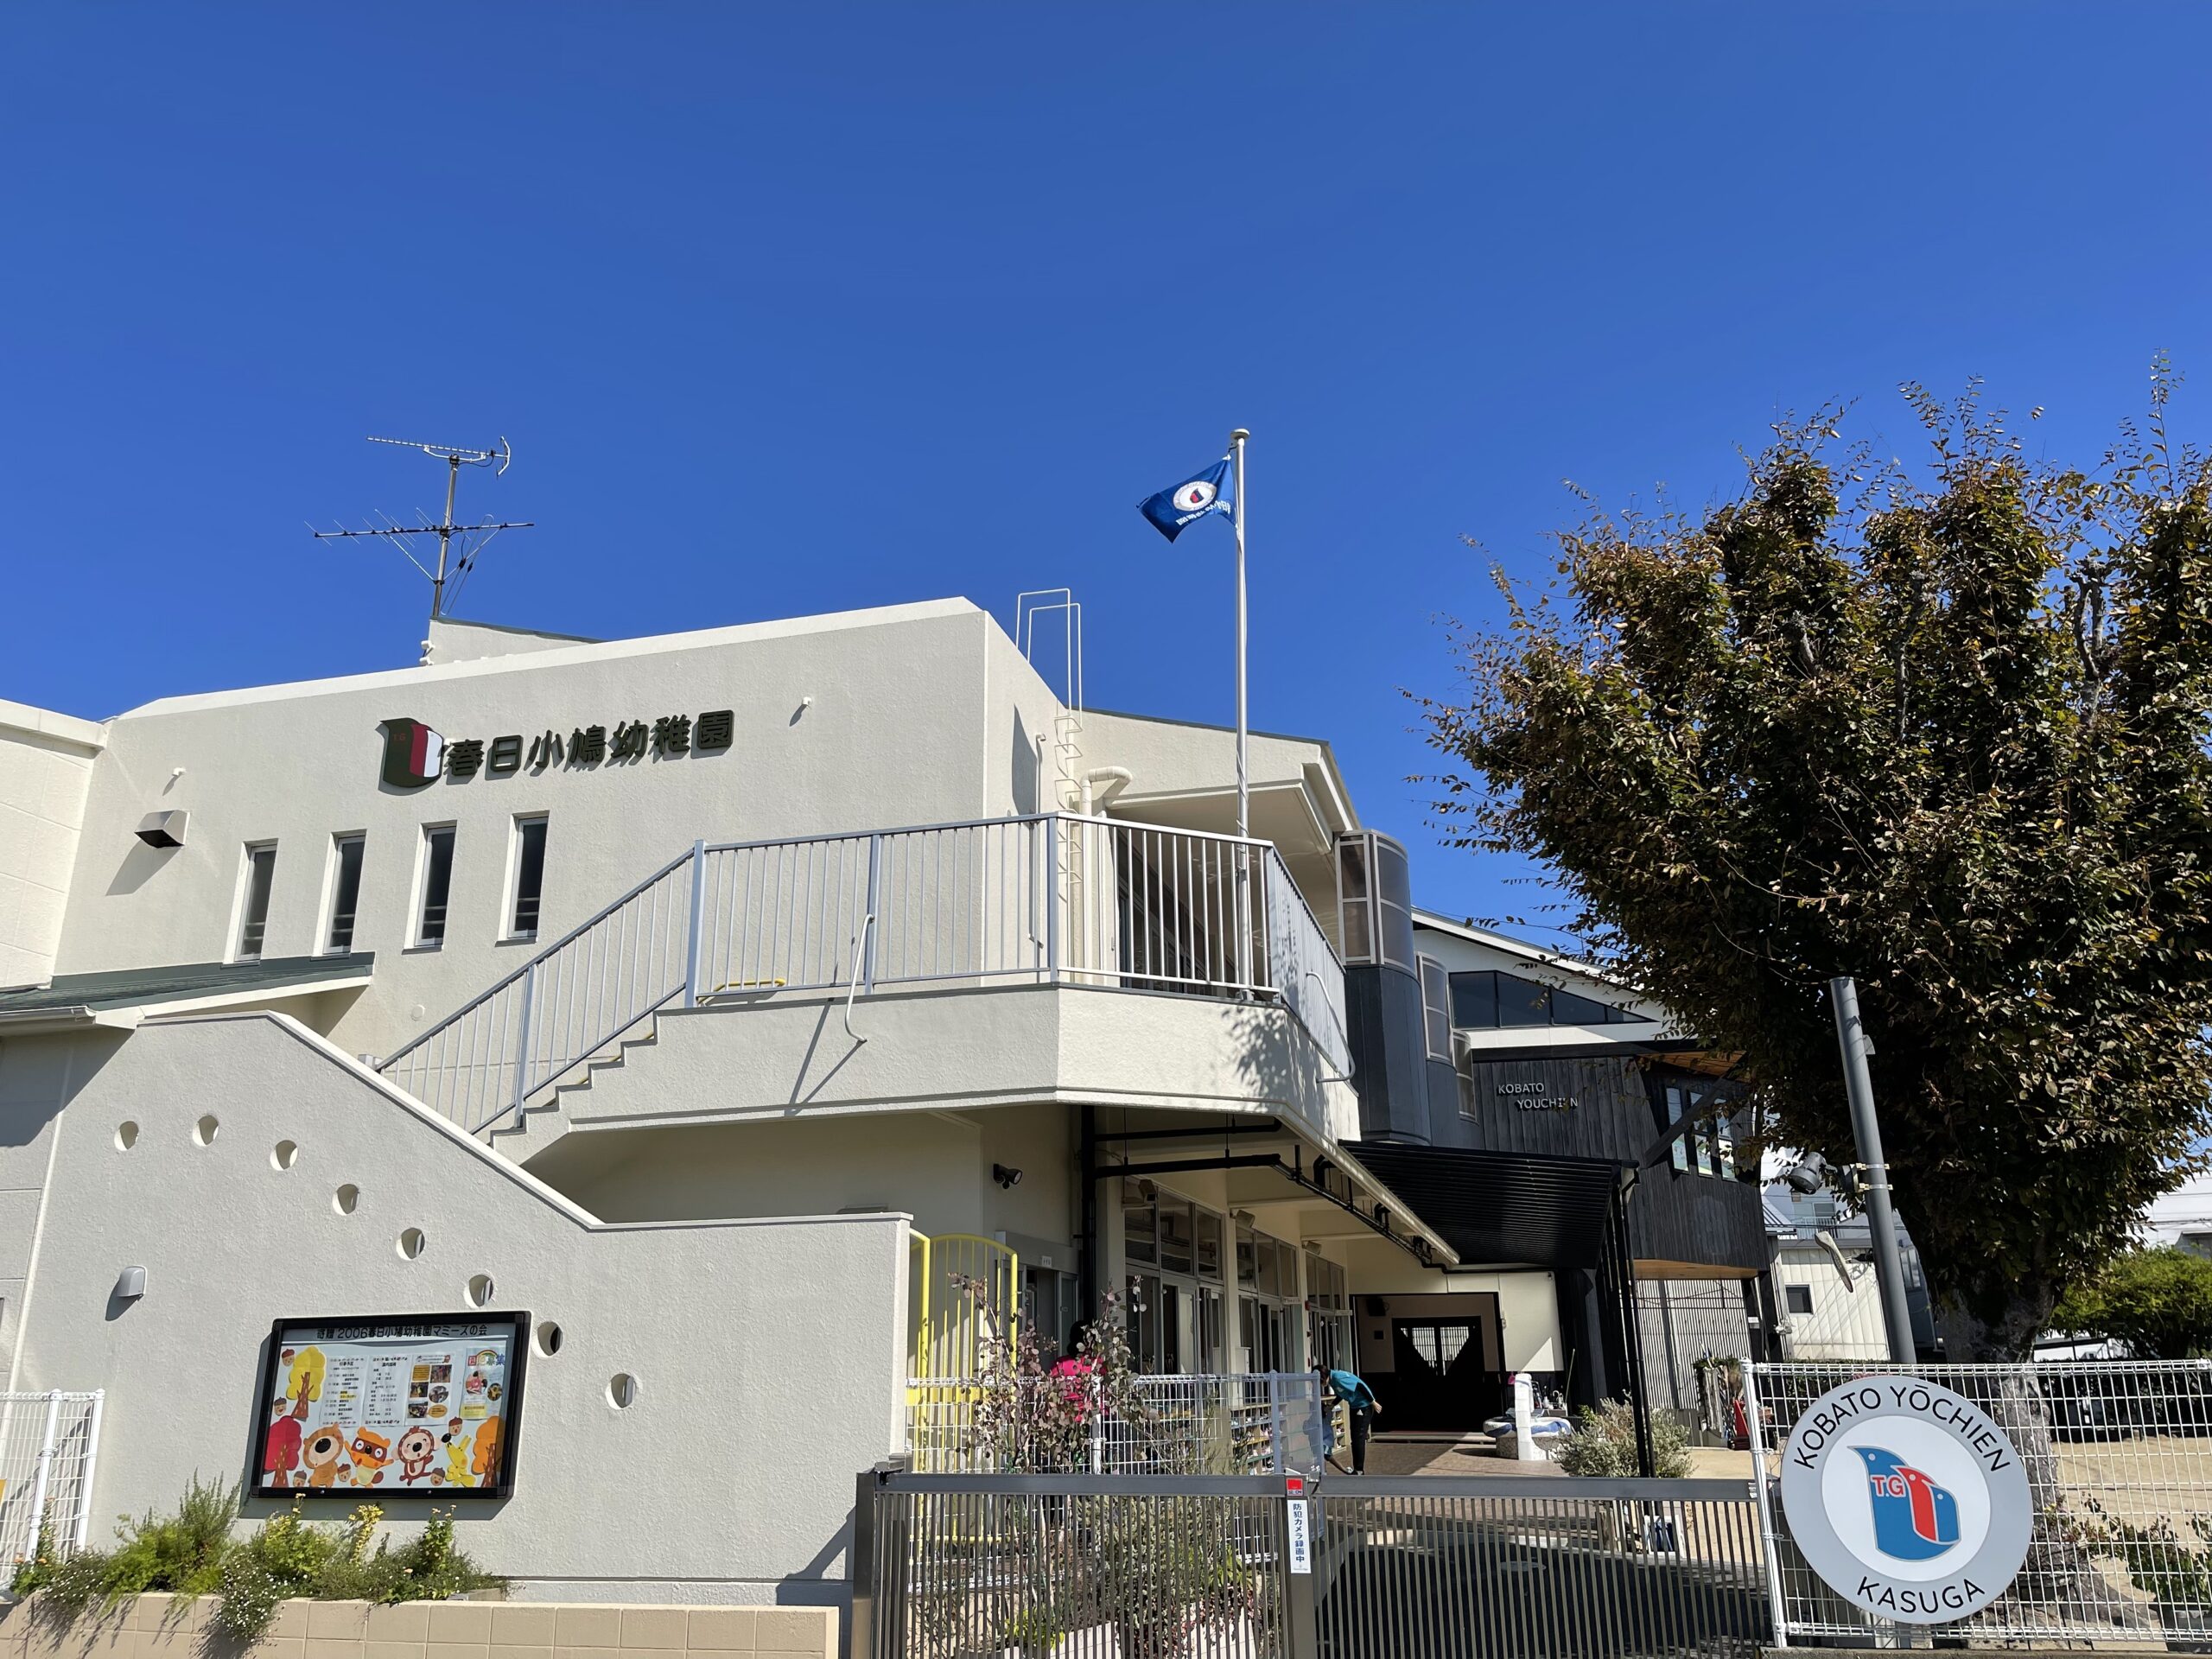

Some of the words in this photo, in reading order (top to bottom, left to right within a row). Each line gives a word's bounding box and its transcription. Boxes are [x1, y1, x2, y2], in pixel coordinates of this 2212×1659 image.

[448, 709, 735, 777] 春日小鳩幼稚園
[1497, 1083, 1545, 1095] KOBATO
[1794, 1388, 1882, 1470] KOBATO
[1889, 1384, 2011, 1472] YŌCHIEN
[1293, 1503, 1305, 1563] 防犯カメラ録画中
[1857, 1576, 1986, 1614] KASUGA
